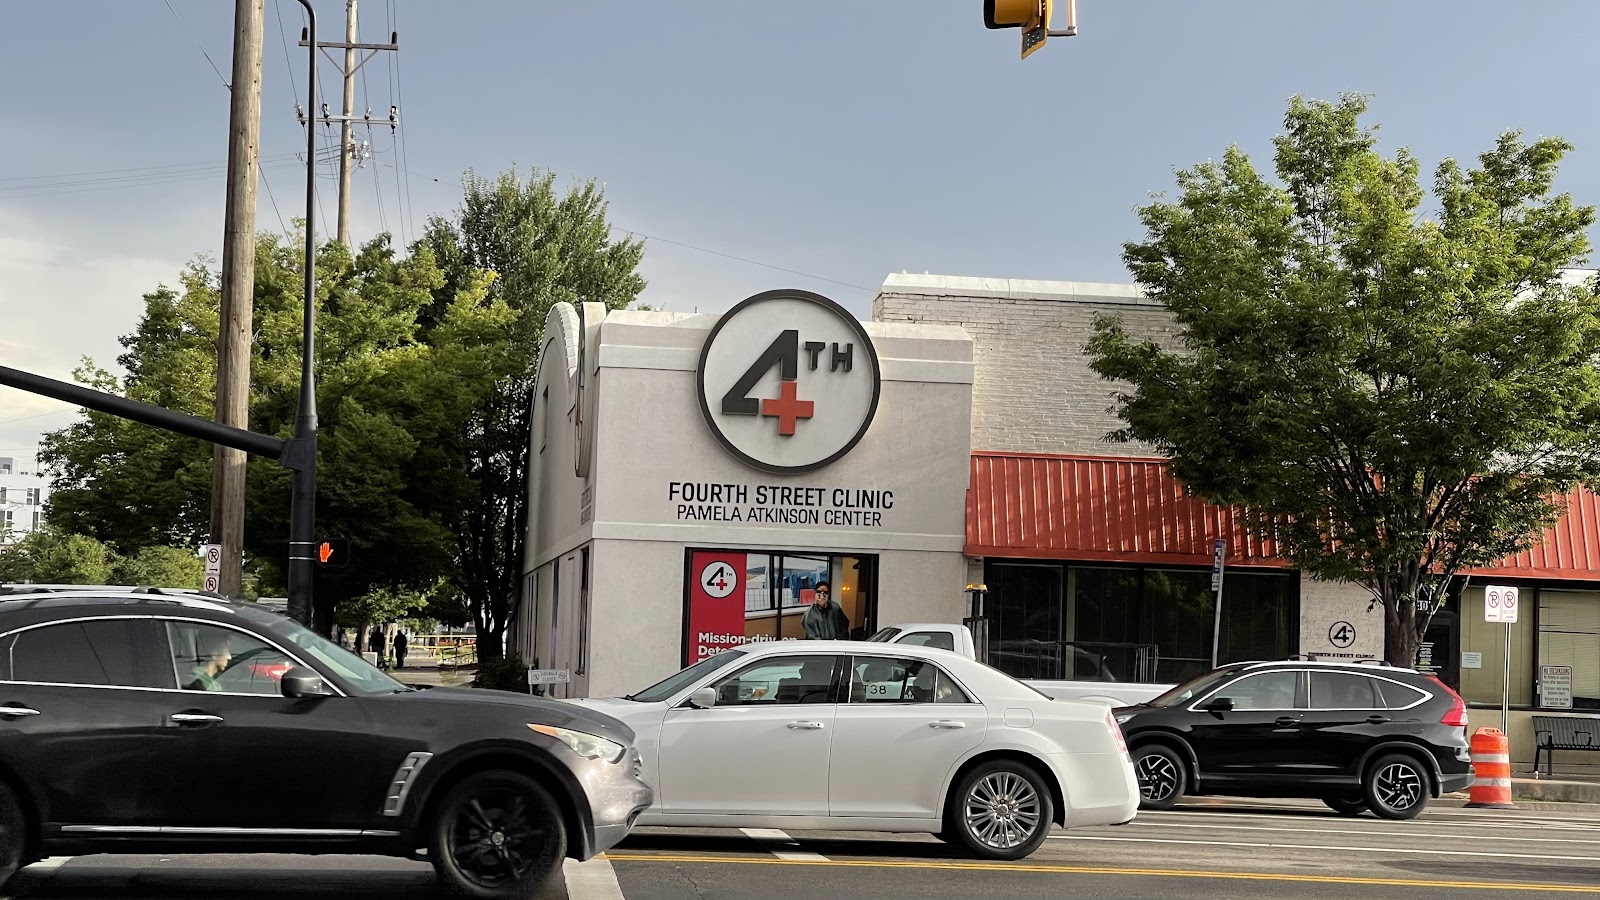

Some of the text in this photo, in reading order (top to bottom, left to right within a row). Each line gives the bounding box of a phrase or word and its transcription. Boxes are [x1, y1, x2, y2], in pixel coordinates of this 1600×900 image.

[668, 482, 894, 509] FOURTH STREET CLINIC
[677, 504, 882, 527] PAMELA ATKINSON CENTER
